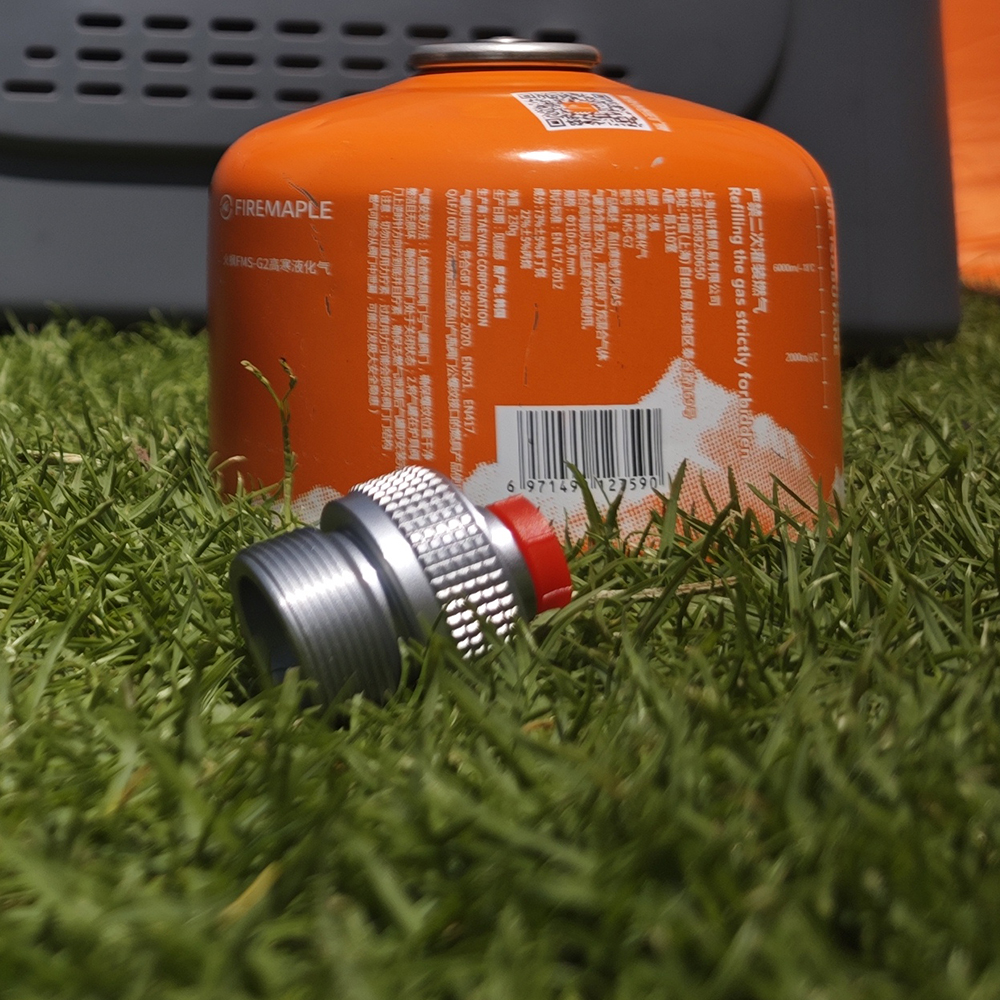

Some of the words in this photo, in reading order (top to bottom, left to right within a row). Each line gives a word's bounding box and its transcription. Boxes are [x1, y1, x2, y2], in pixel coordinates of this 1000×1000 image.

[235, 199, 334, 219] FIREMAPLE
[728, 187, 745, 245] Refilling
[733, 249, 747, 273] the
[744, 187, 767, 314] 严禁二次灌装燃气
[477, 259, 489, 327] CORPORATION
[731, 278, 746, 305] gas
[734, 310, 751, 367] strictly
[737, 371, 754, 459] forbidden
